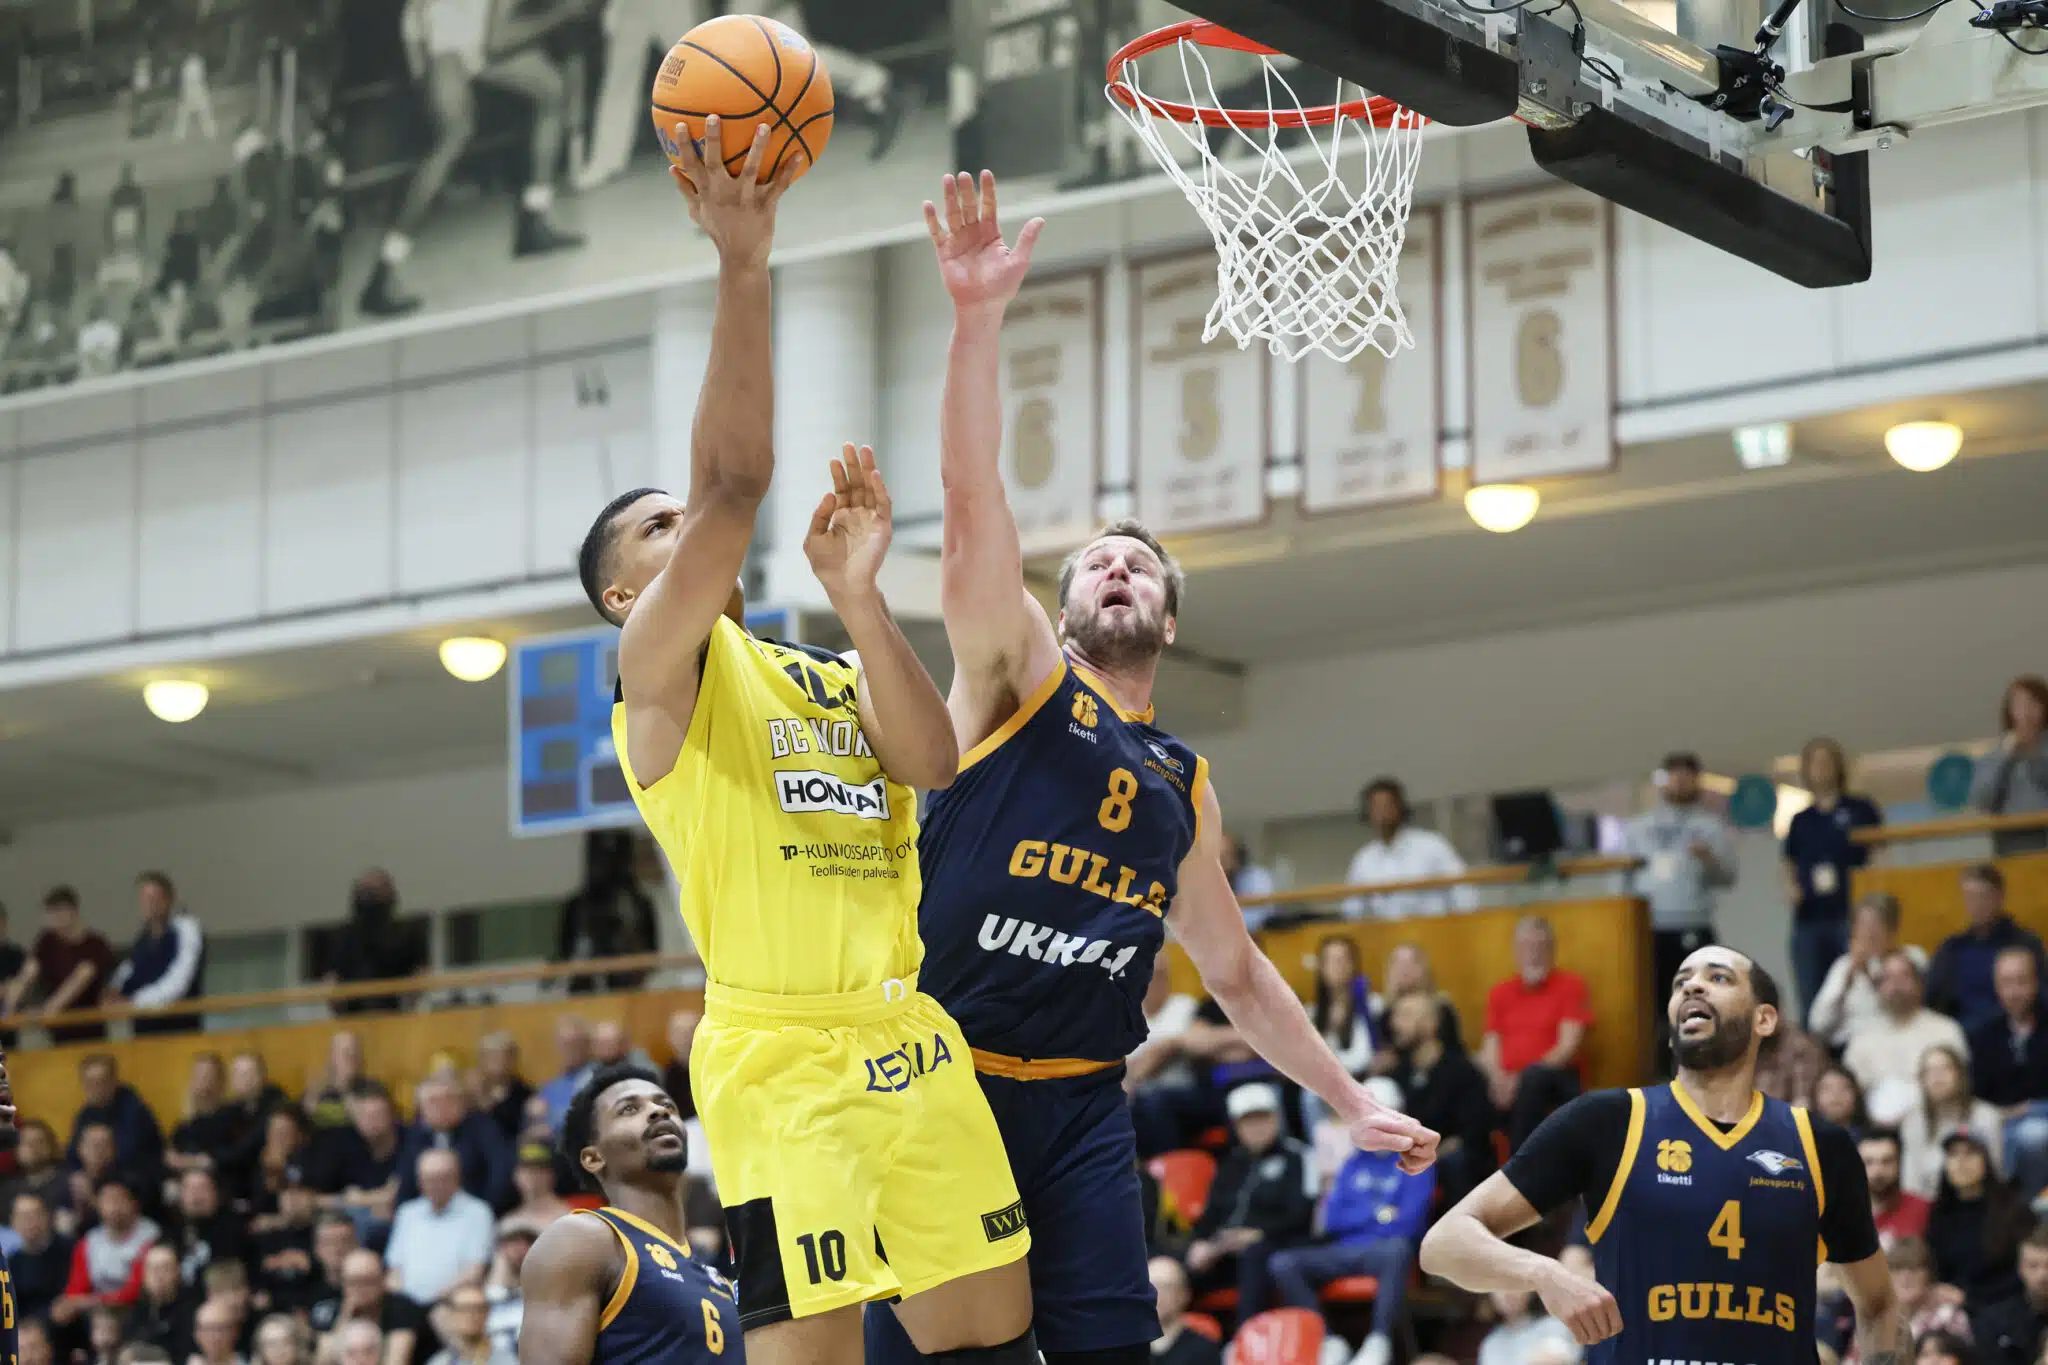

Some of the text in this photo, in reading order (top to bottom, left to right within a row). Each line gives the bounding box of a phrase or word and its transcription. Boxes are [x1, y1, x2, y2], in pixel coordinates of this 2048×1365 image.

[767, 718, 810, 760] BC
[1097, 767, 1139, 833] 8
[895, 836, 912, 859] OY
[1008, 839, 1168, 919] GULLS
[797, 1229, 847, 1285] 10
[1707, 1200, 1746, 1260] 4
[701, 1298, 725, 1356] 6
[1647, 1282, 1797, 1333] GULLS
